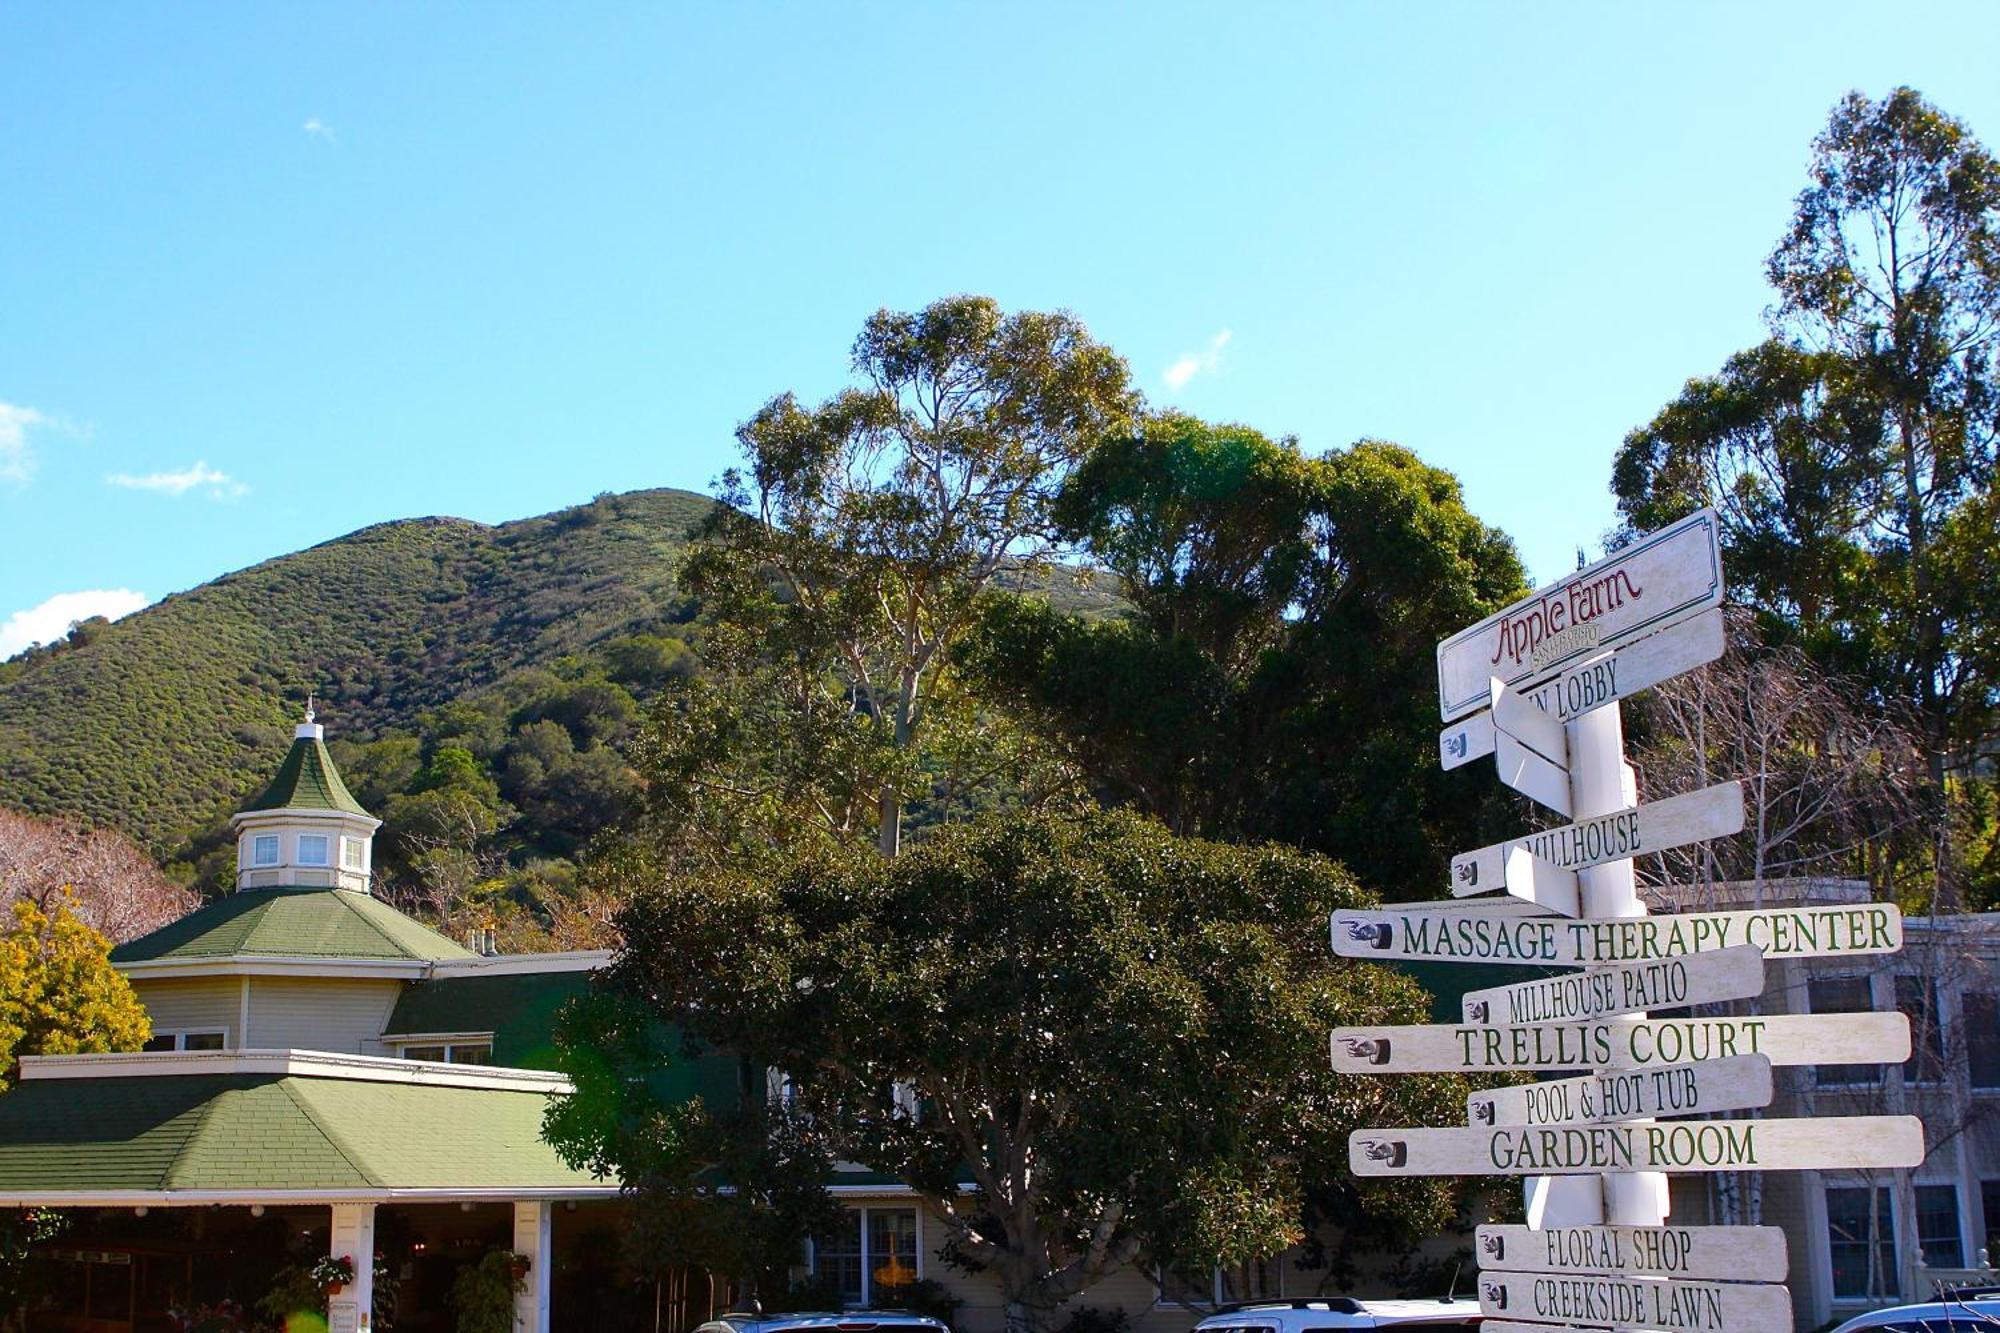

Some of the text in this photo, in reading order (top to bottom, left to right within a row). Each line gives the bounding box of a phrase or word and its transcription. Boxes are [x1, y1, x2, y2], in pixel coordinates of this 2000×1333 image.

[1492, 570, 1641, 664] Apple Farm
[1556, 659, 1617, 718] LOBBY
[1401, 910, 1894, 960] MASSAGE THERAPY CENTER
[1508, 961, 1686, 1022] MILLHOUSE PATIO
[1456, 1022, 1766, 1066] TRELLIS COURT
[1526, 1069, 1698, 1124] POOL & HOT TUB
[1490, 1125, 1757, 1169] GARDEN ROOM
[1547, 1230, 1691, 1271] FLORAL SHOP
[1534, 1279, 1723, 1329] CREEKSIDE LAWN
